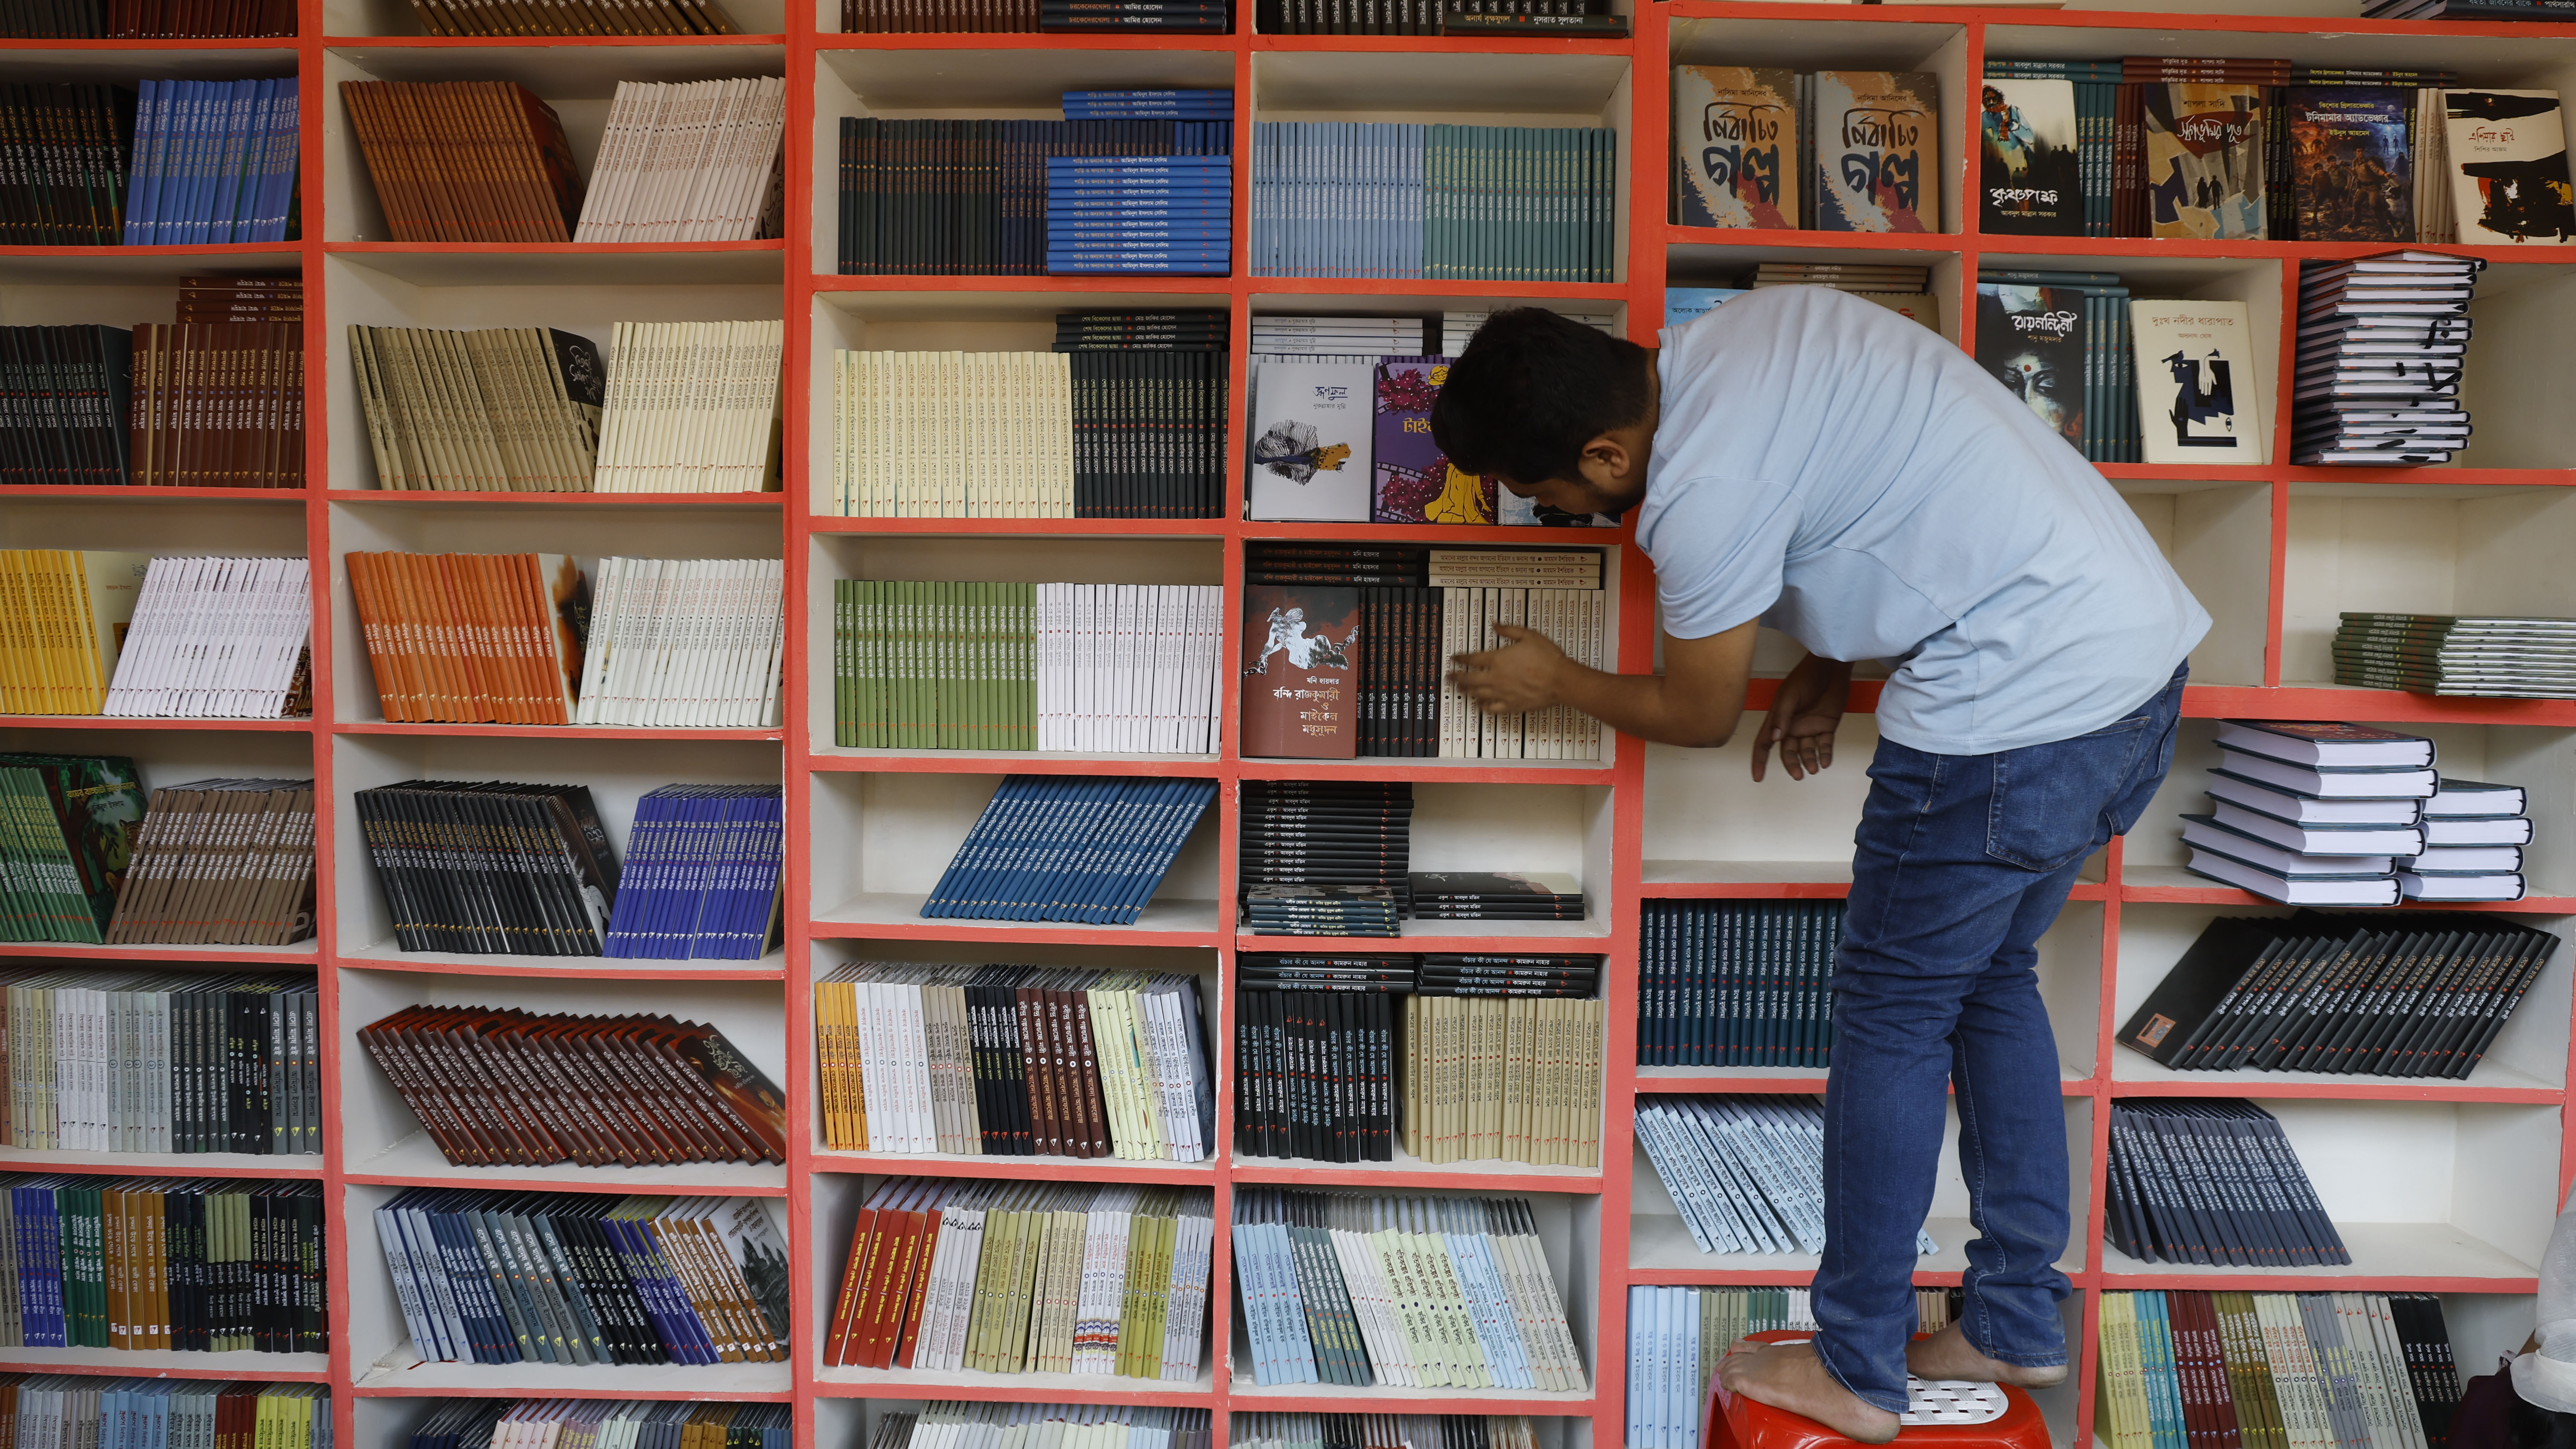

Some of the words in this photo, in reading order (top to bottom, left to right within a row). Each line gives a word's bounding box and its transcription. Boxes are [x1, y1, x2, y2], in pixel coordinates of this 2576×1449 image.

[1464, 14, 1482, 22] অনার্য
[1534, 16, 1555, 24] নুসরাত
[1558, 16, 1583, 25] সুলতানা
[1718, 88, 1738, 96] নাসিমা
[2208, 99, 2226, 108] সাদি
[1703, 101, 1787, 142] নির্বাচিত
[2305, 111, 2342, 122] টনিমামার
[2344, 113, 2389, 122] অ্যাডভেঞ্চার
[1842, 108, 1927, 148] নির্বাচিত
[2227, 123, 2242, 143] দূত
[1702, 144, 1779, 205] গল্প
[1841, 150, 1919, 212] গল্প
[2011, 311, 2078, 337] রায়নন্দিনী
[2173, 314, 2195, 325] নদীর
[2198, 317, 2233, 326] ধারাপাত
[1403, 417, 1432, 433] টাই
[1273, 687, 1292, 701] বন্দি
[1295, 687, 1340, 703] রাজকুমারী
[1300, 709, 1338, 721] মাইকেল
[1302, 724, 1337, 737] মধুসূদন
[288, 1029, 296, 1044] মানুষ
[1077, 1004, 1086, 1019] রবীন্দ্র
[1082, 1044, 1091, 1056] নারী
[289, 1046, 299, 1055] হই
[291, 1071, 300, 1094] আমিনুল
